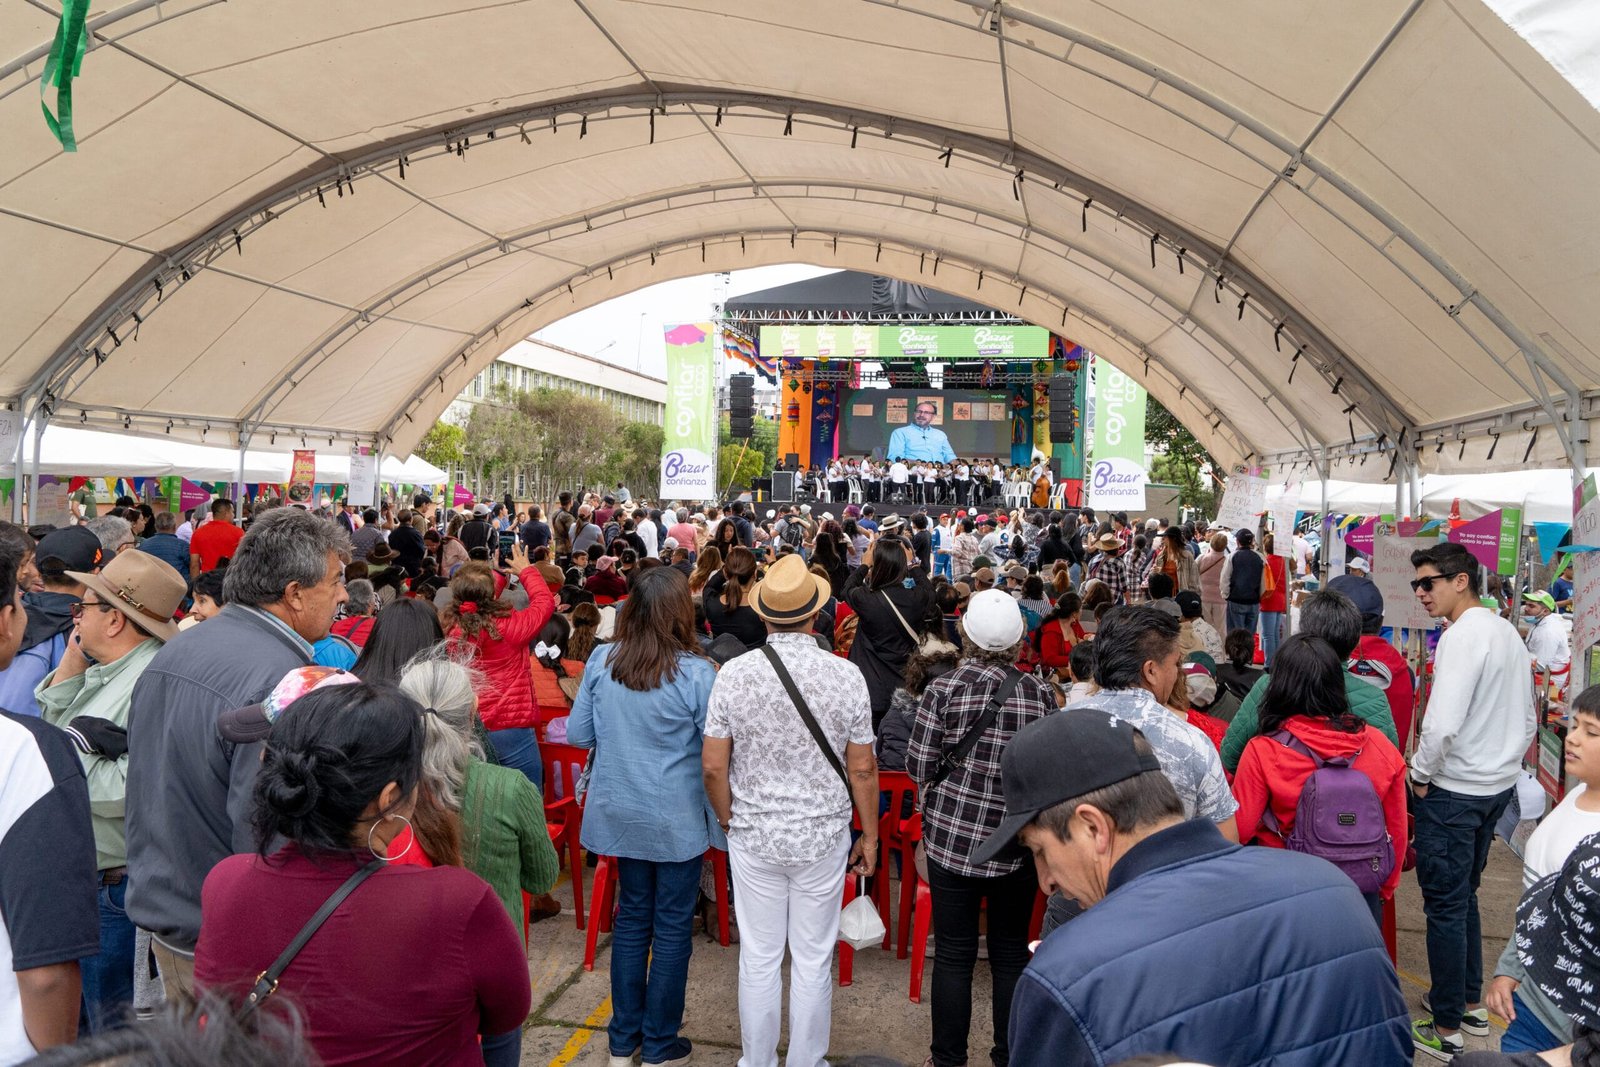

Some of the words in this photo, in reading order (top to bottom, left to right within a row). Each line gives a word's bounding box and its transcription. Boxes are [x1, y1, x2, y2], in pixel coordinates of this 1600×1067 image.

[898, 327, 938, 345] Bazar
[974, 327, 1014, 345] Bazar
[674, 362, 696, 437] confiar
[665, 452, 710, 478] Bazar
[666, 477, 707, 486] confianza
[1094, 461, 1141, 488] Bazar
[1094, 488, 1139, 496] confianza
